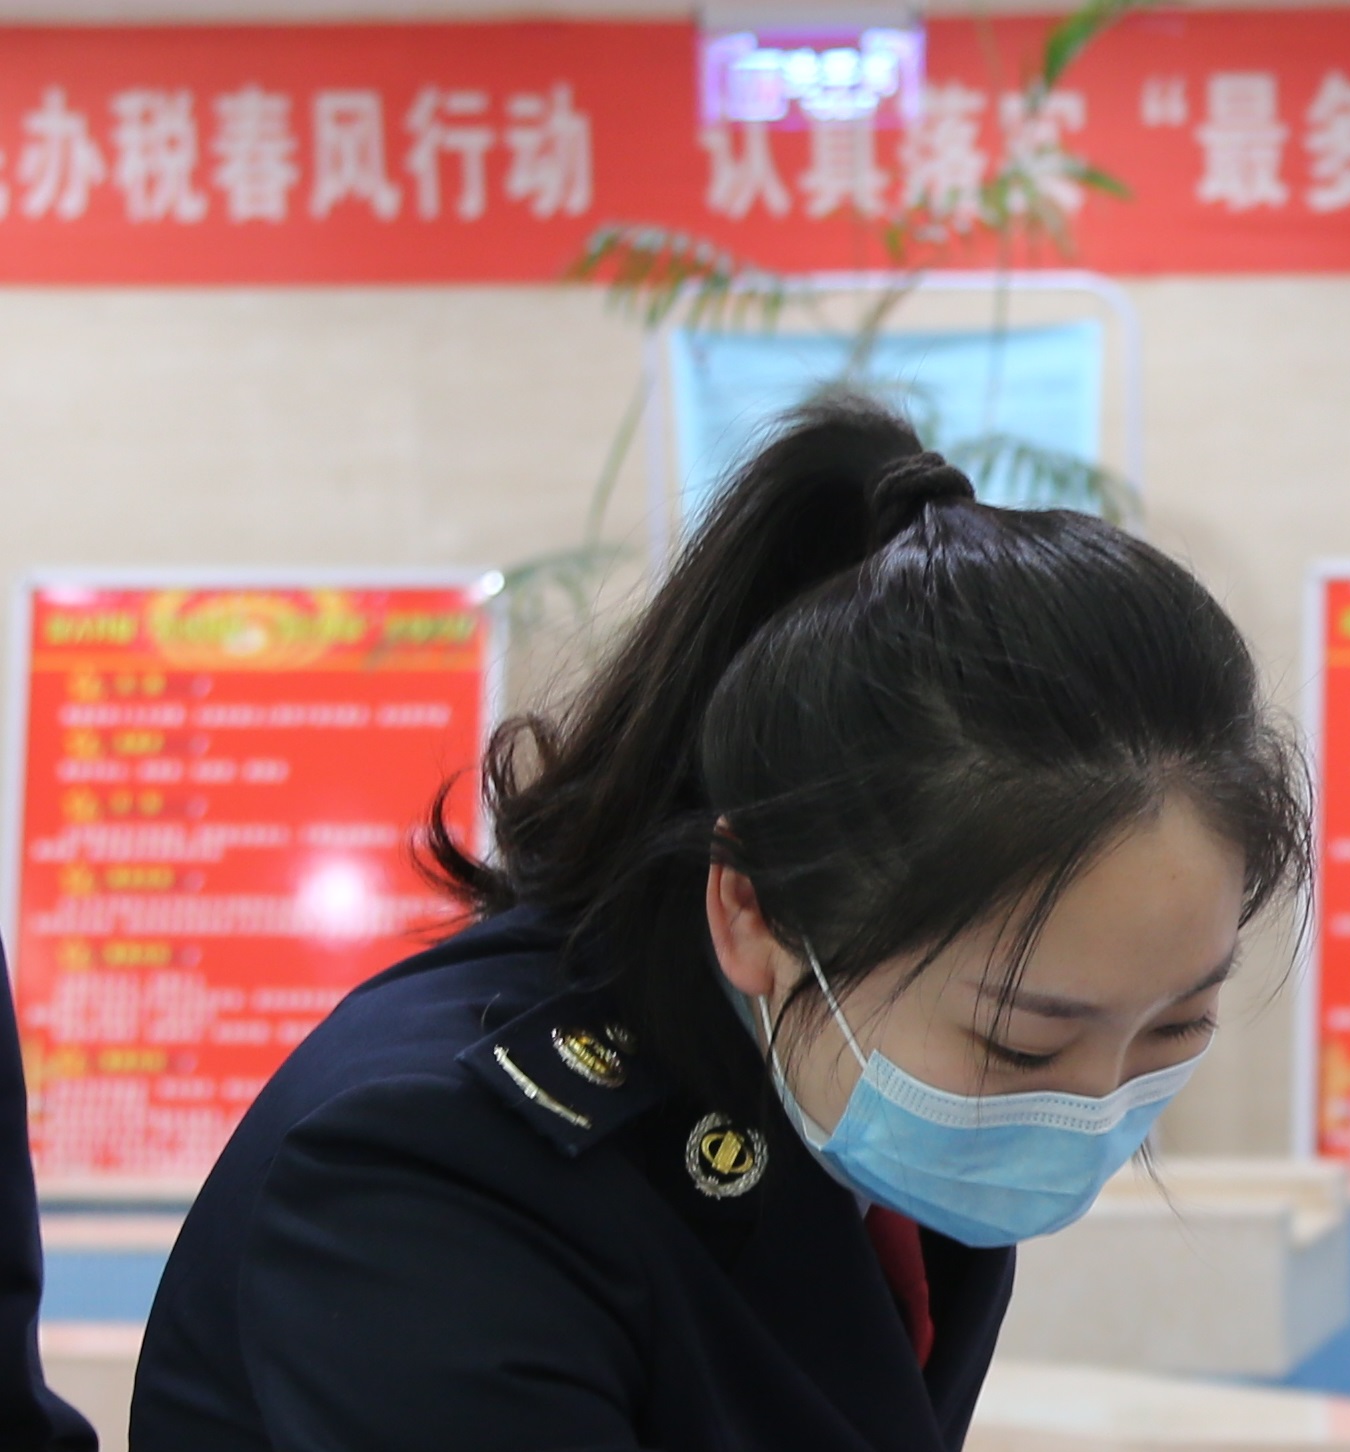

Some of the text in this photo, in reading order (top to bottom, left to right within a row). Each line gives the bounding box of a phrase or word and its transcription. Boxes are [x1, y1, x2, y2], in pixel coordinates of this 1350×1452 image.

[0, 84, 596, 222] 办税春风行动
